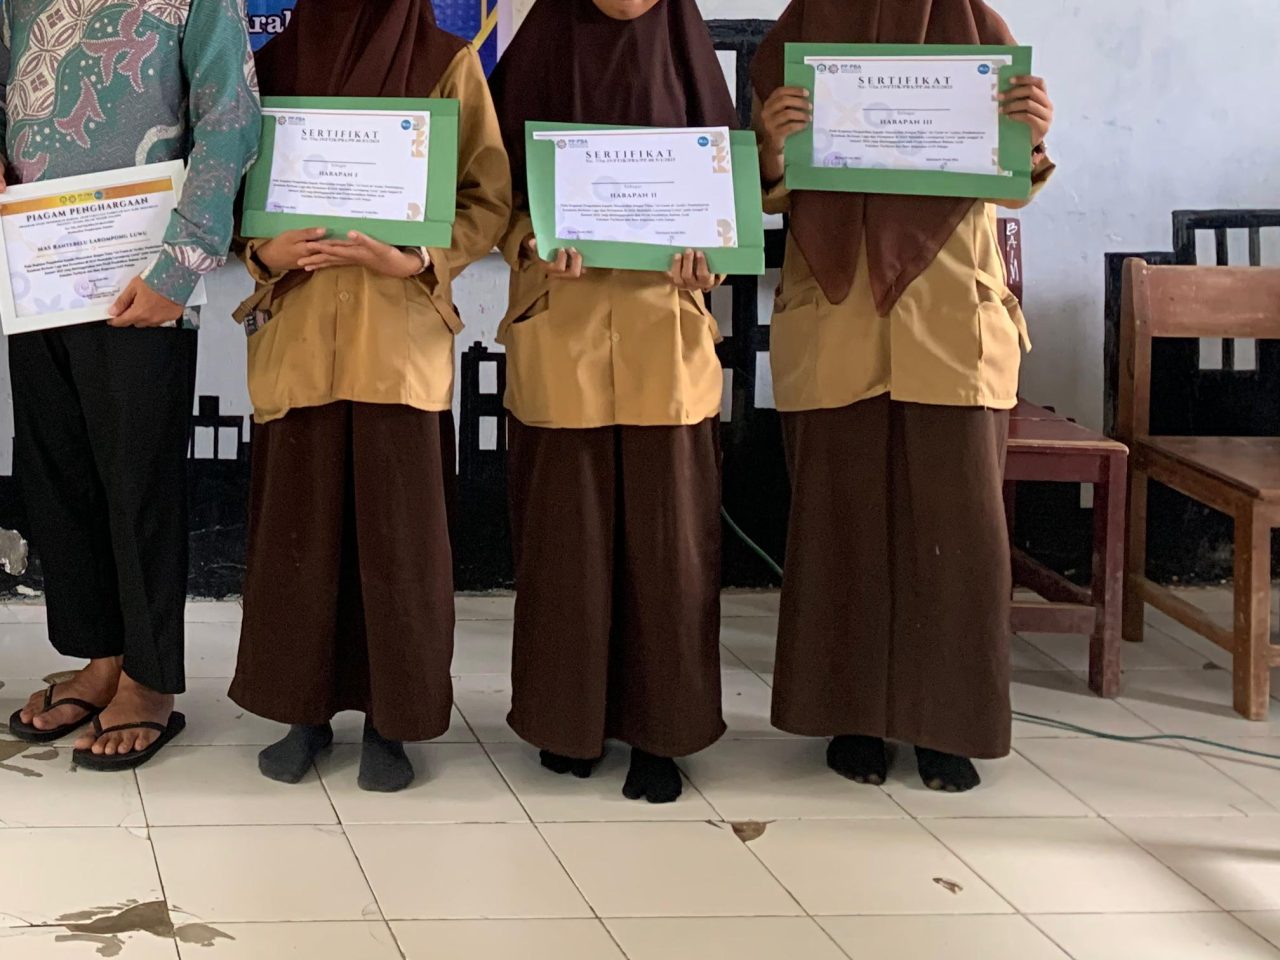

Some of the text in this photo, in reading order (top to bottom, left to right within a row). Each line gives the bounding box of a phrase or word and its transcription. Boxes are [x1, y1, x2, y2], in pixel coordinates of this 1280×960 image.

[858, 76, 951, 85] SERTIFIKAT
[302, 129, 379, 139] SERTIFIKAT
[585, 149, 673, 159] SERTIFIKAT
[26, 197, 148, 222] PIAGAM PENGHARGAAN
